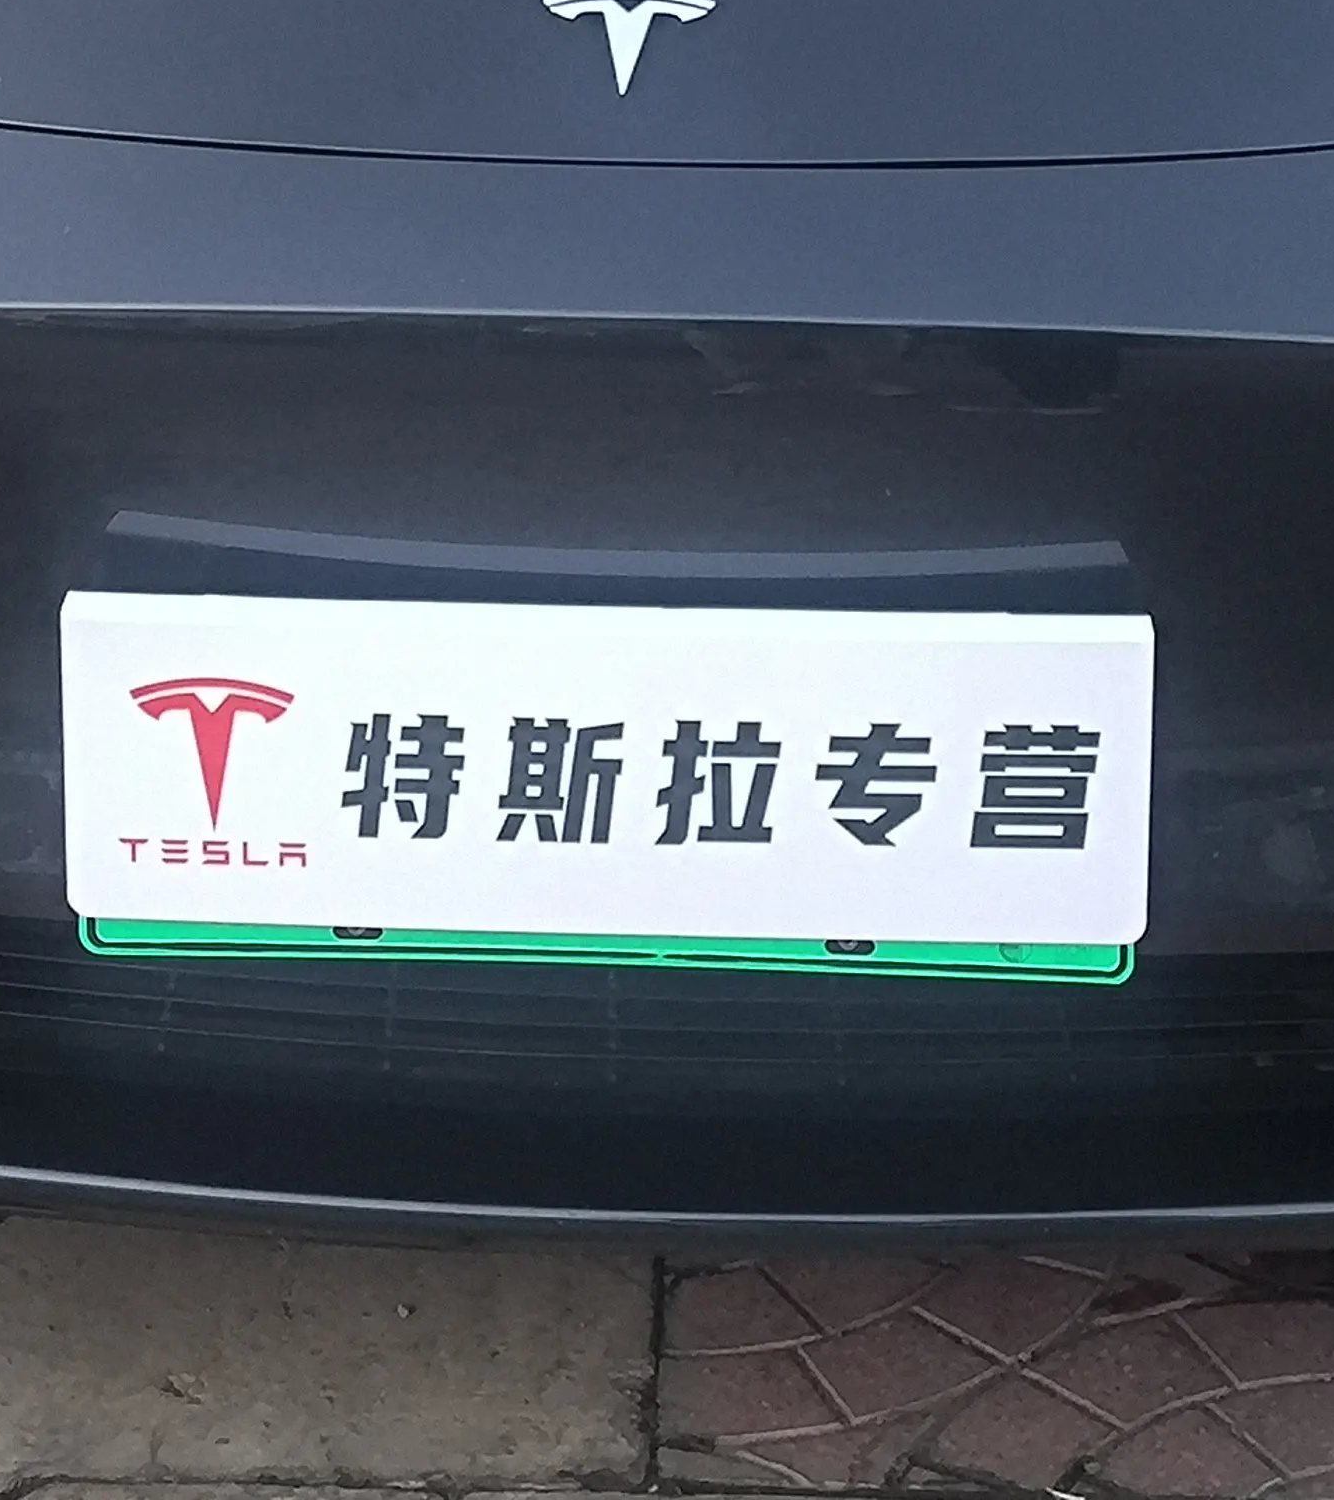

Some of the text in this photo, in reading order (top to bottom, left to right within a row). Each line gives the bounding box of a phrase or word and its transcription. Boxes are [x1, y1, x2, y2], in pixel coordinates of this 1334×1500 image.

[341, 713, 1101, 850] 特斯拉专营
[118, 837, 307, 868] TESLA
